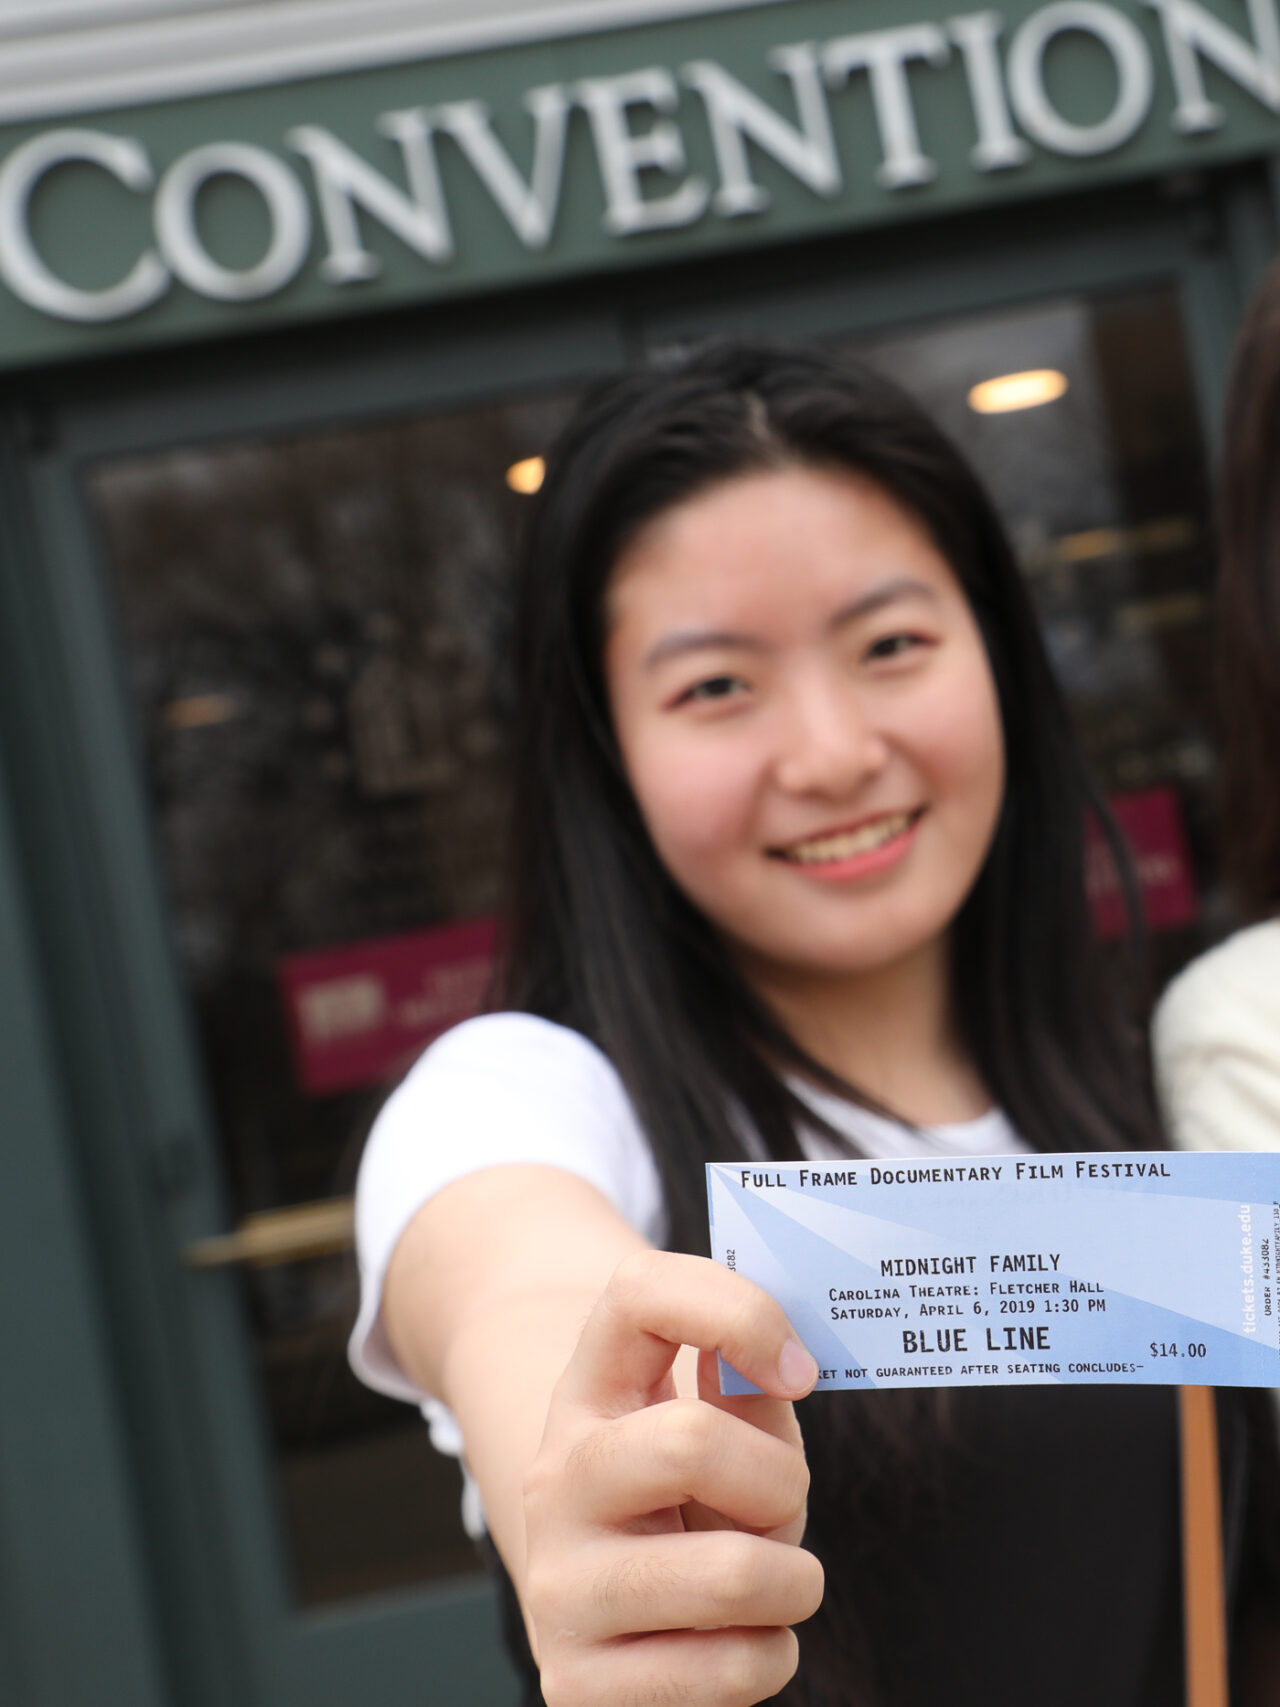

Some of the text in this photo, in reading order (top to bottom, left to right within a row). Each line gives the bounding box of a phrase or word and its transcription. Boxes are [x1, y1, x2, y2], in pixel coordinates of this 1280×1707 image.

[880, 1253, 1060, 1277] MIDNIGHT FAMILY
[1236, 1203, 1256, 1335] tickets.duke.edu
[1261, 1237, 1271, 1281] #433082
[829, 1287, 900, 1301] CAROLINA
[973, 1302, 989, 1317] 6,
[1000, 1300, 1036, 1314] 2019
[1045, 1299, 1079, 1313] 1:30
[1088, 1298, 1106, 1313] PM
[902, 1326, 1050, 1353] BLUE LINE
[1149, 1342, 1207, 1358] $14.00
[845, 1368, 868, 1379] NOT
[876, 1365, 953, 1378] GUARANTEED
[960, 1364, 999, 1375] AFTER
[1007, 1363, 1061, 1374] SEATING
